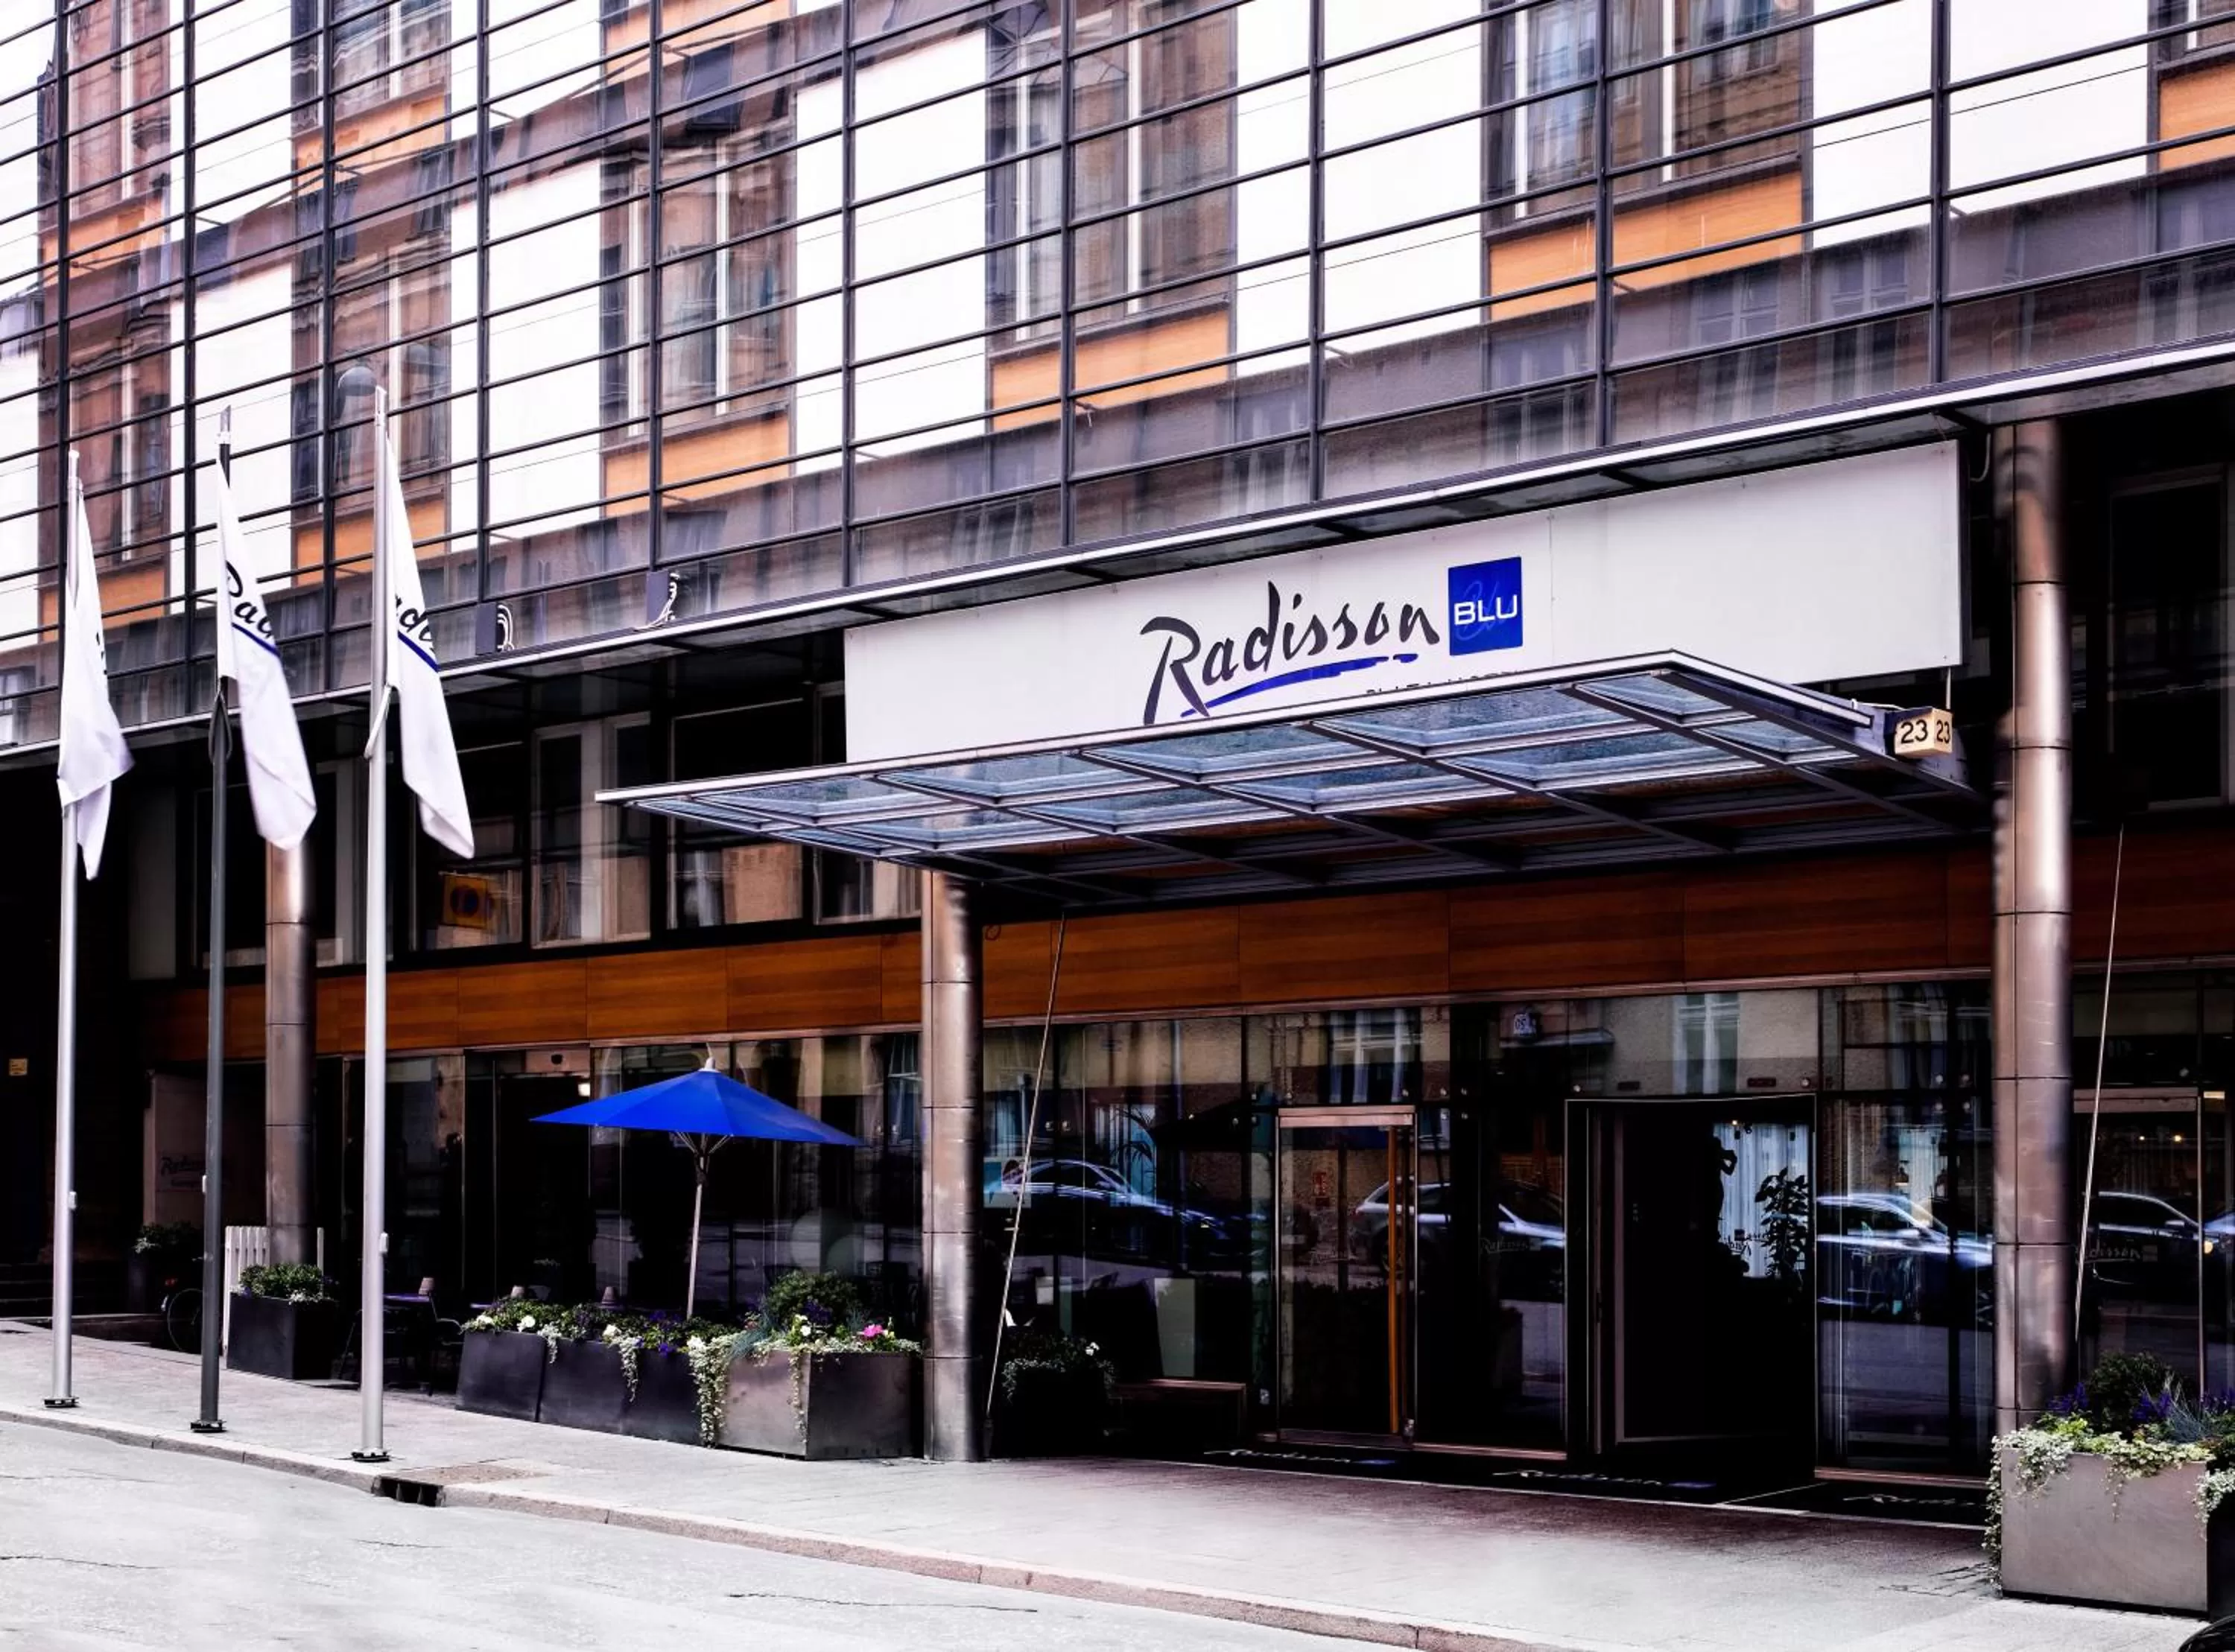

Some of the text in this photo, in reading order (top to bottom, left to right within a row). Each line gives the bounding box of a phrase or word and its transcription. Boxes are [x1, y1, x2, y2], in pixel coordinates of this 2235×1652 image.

[1140, 580, 1518, 725] Radisson BLU
[1900, 719, 1928, 744] 23
[1936, 719, 1951, 744] 23
